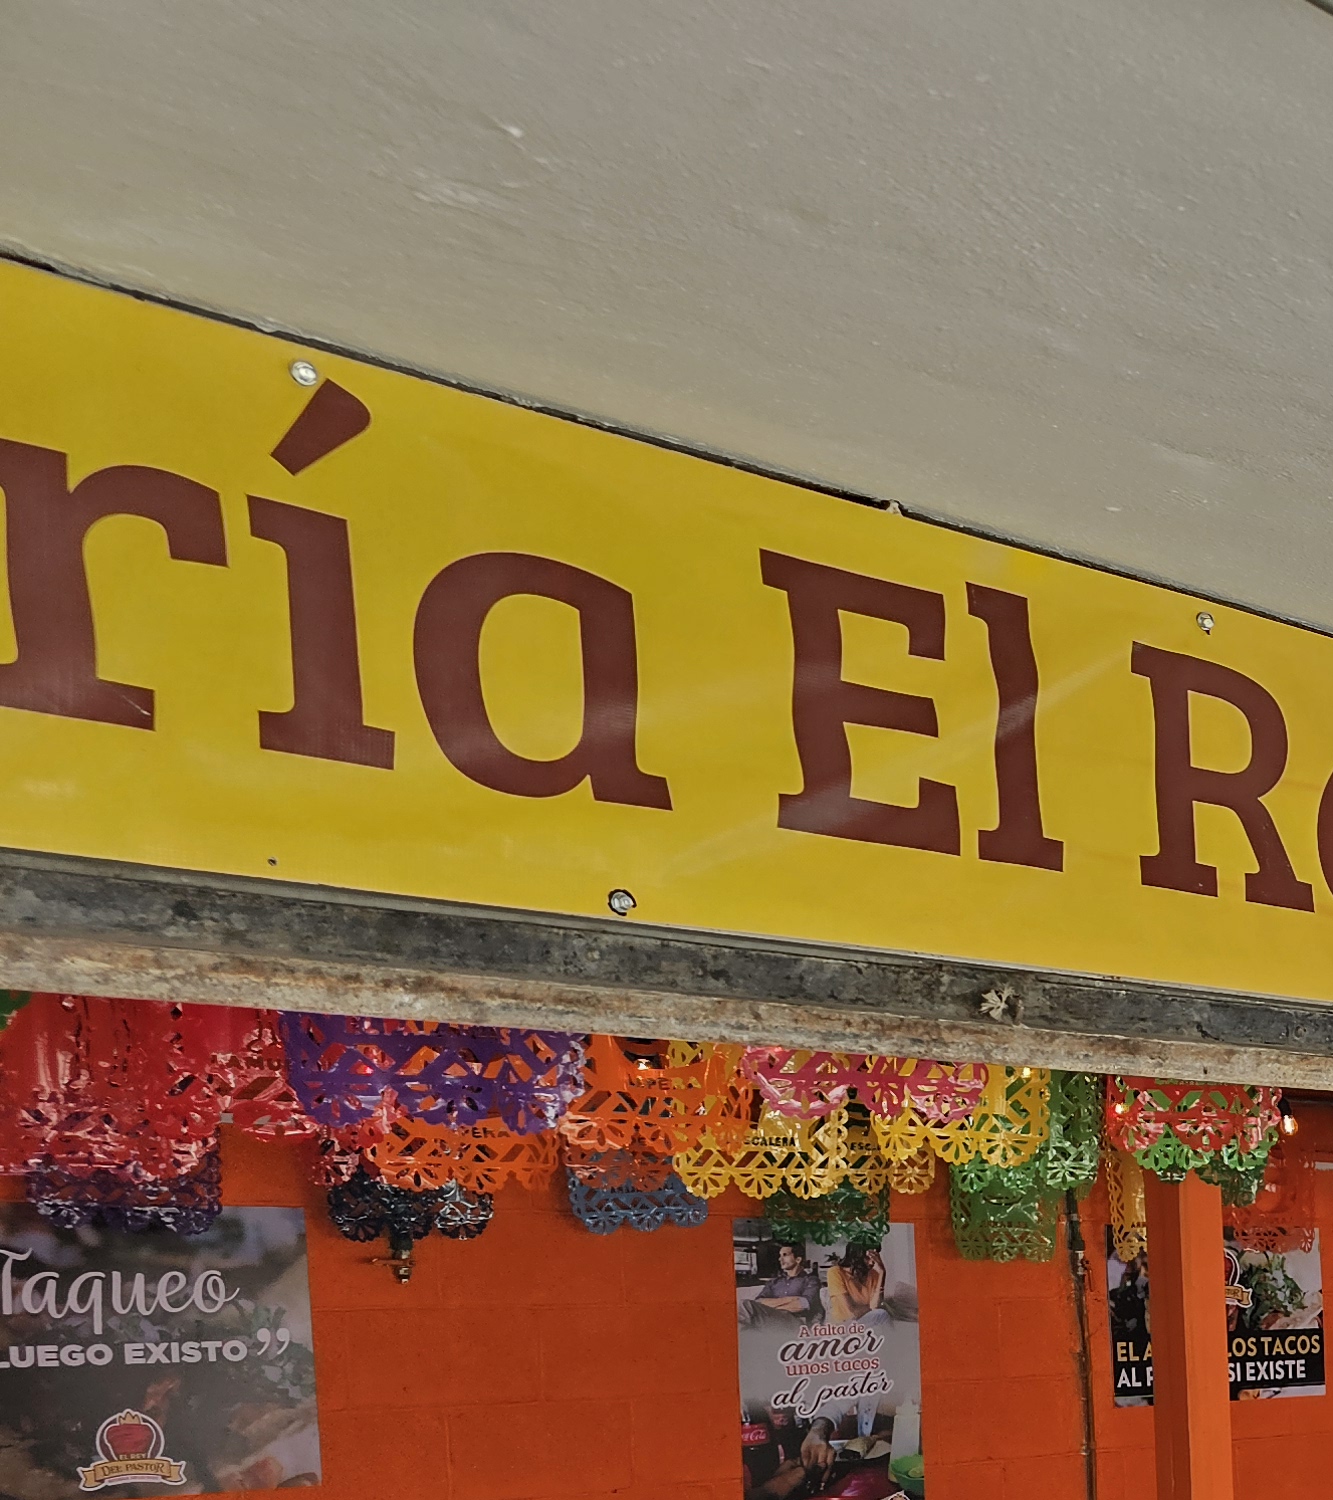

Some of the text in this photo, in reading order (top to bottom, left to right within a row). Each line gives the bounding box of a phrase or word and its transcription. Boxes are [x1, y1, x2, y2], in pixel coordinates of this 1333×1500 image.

[759, 547, 1065, 872] El
[0, 1247, 241, 1335] Taqueo
[799, 1322, 865, 1338] A falta de
[780, 1330, 884, 1362] amor
[1116, 1341, 1139, 1362] EL
[1261, 1335, 1321, 1357] TACOS
[785, 1357, 880, 1376] unos tacos
[1117, 1368, 1142, 1388] AL
[1246, 1359, 1307, 1382] EXISTE
[773, 1371, 892, 1416] al pastor
[125, 1462, 165, 1474] PASTOR
